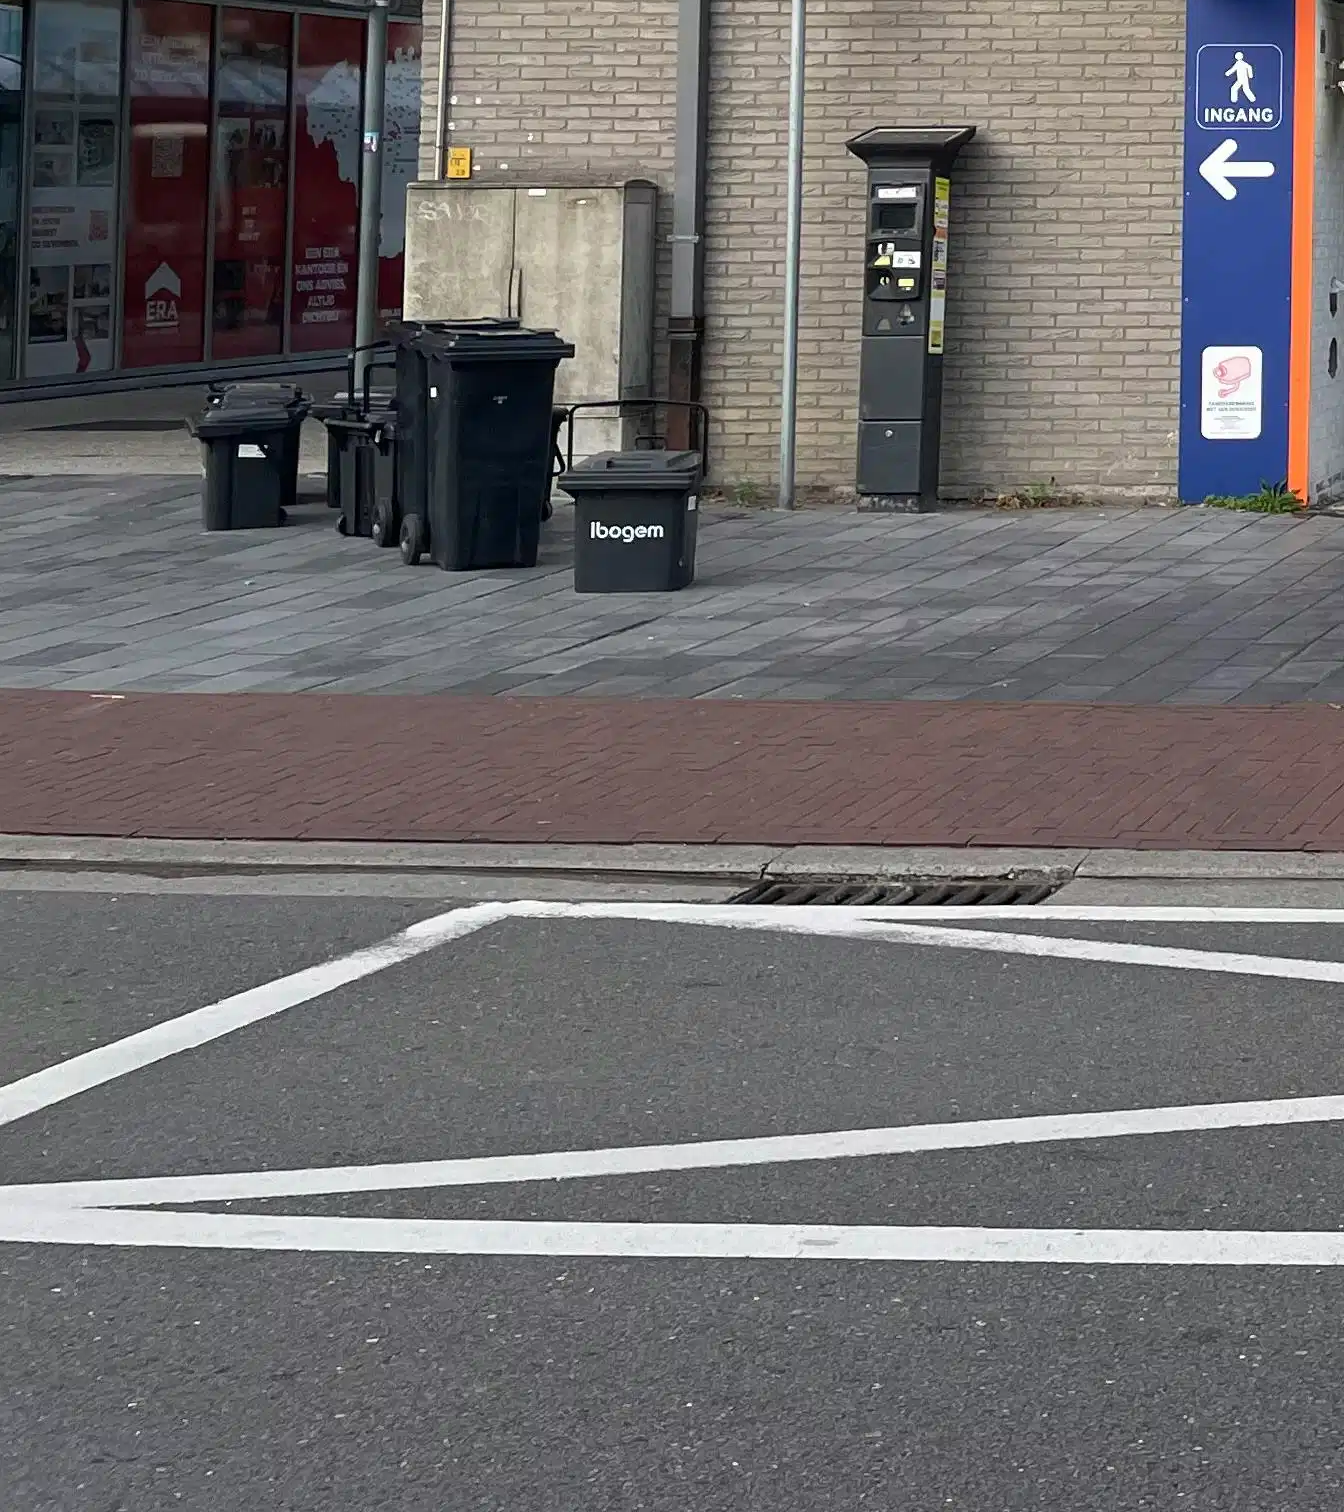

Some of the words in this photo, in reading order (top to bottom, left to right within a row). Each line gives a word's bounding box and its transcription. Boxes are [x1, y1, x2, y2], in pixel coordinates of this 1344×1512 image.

[1204, 107, 1274, 124] INGANG
[146, 300, 179, 320] ERA
[590, 521, 664, 543] Ibogem
